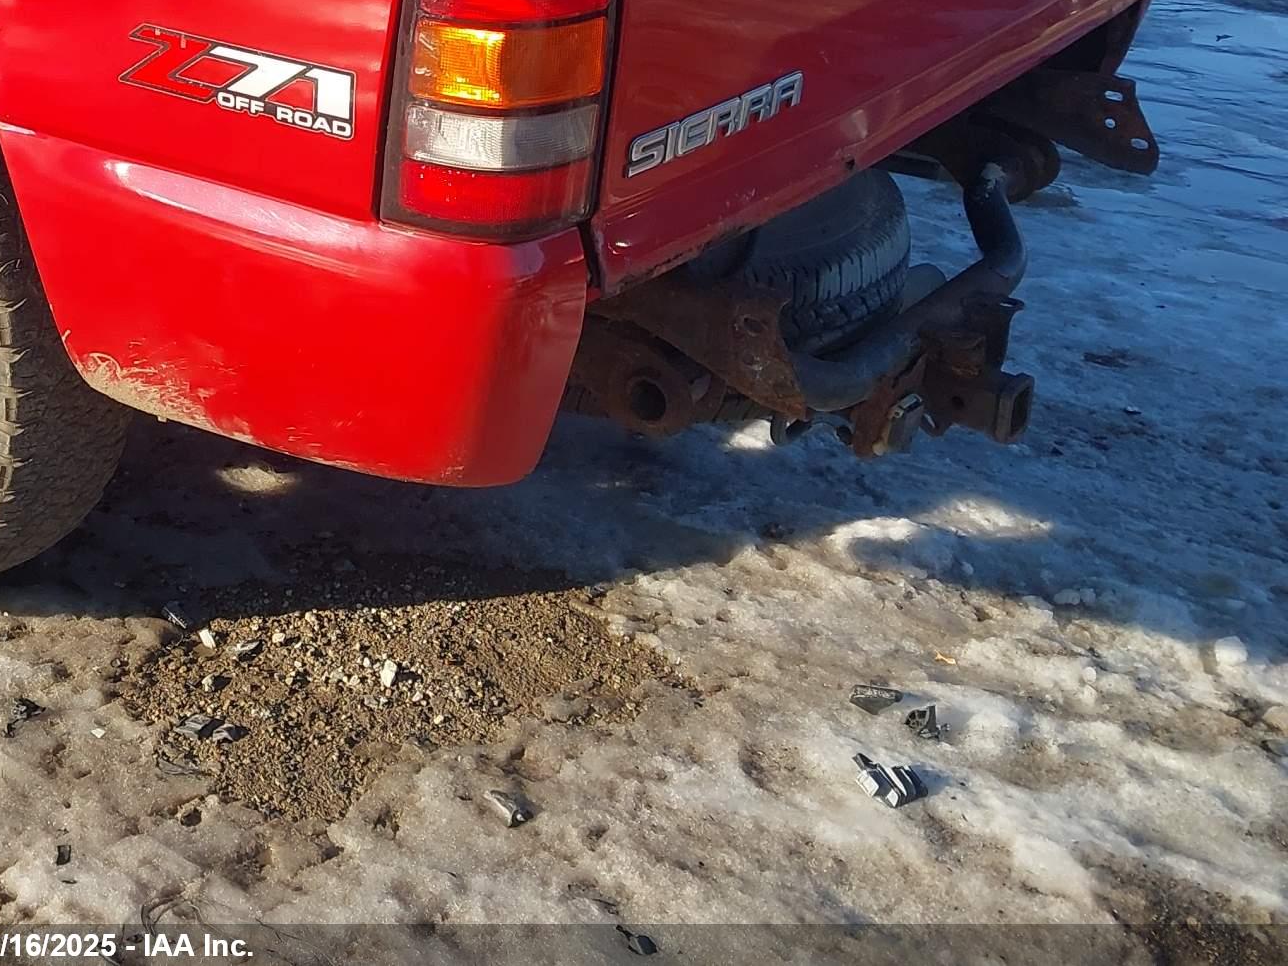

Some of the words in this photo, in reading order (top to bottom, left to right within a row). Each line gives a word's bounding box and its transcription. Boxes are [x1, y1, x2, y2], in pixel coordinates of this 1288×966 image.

[118, 23, 356, 119] Z71
[216, 91, 266, 115] OFF
[276, 107, 352, 139] ROAD
[625, 70, 804, 178] SIERRA
